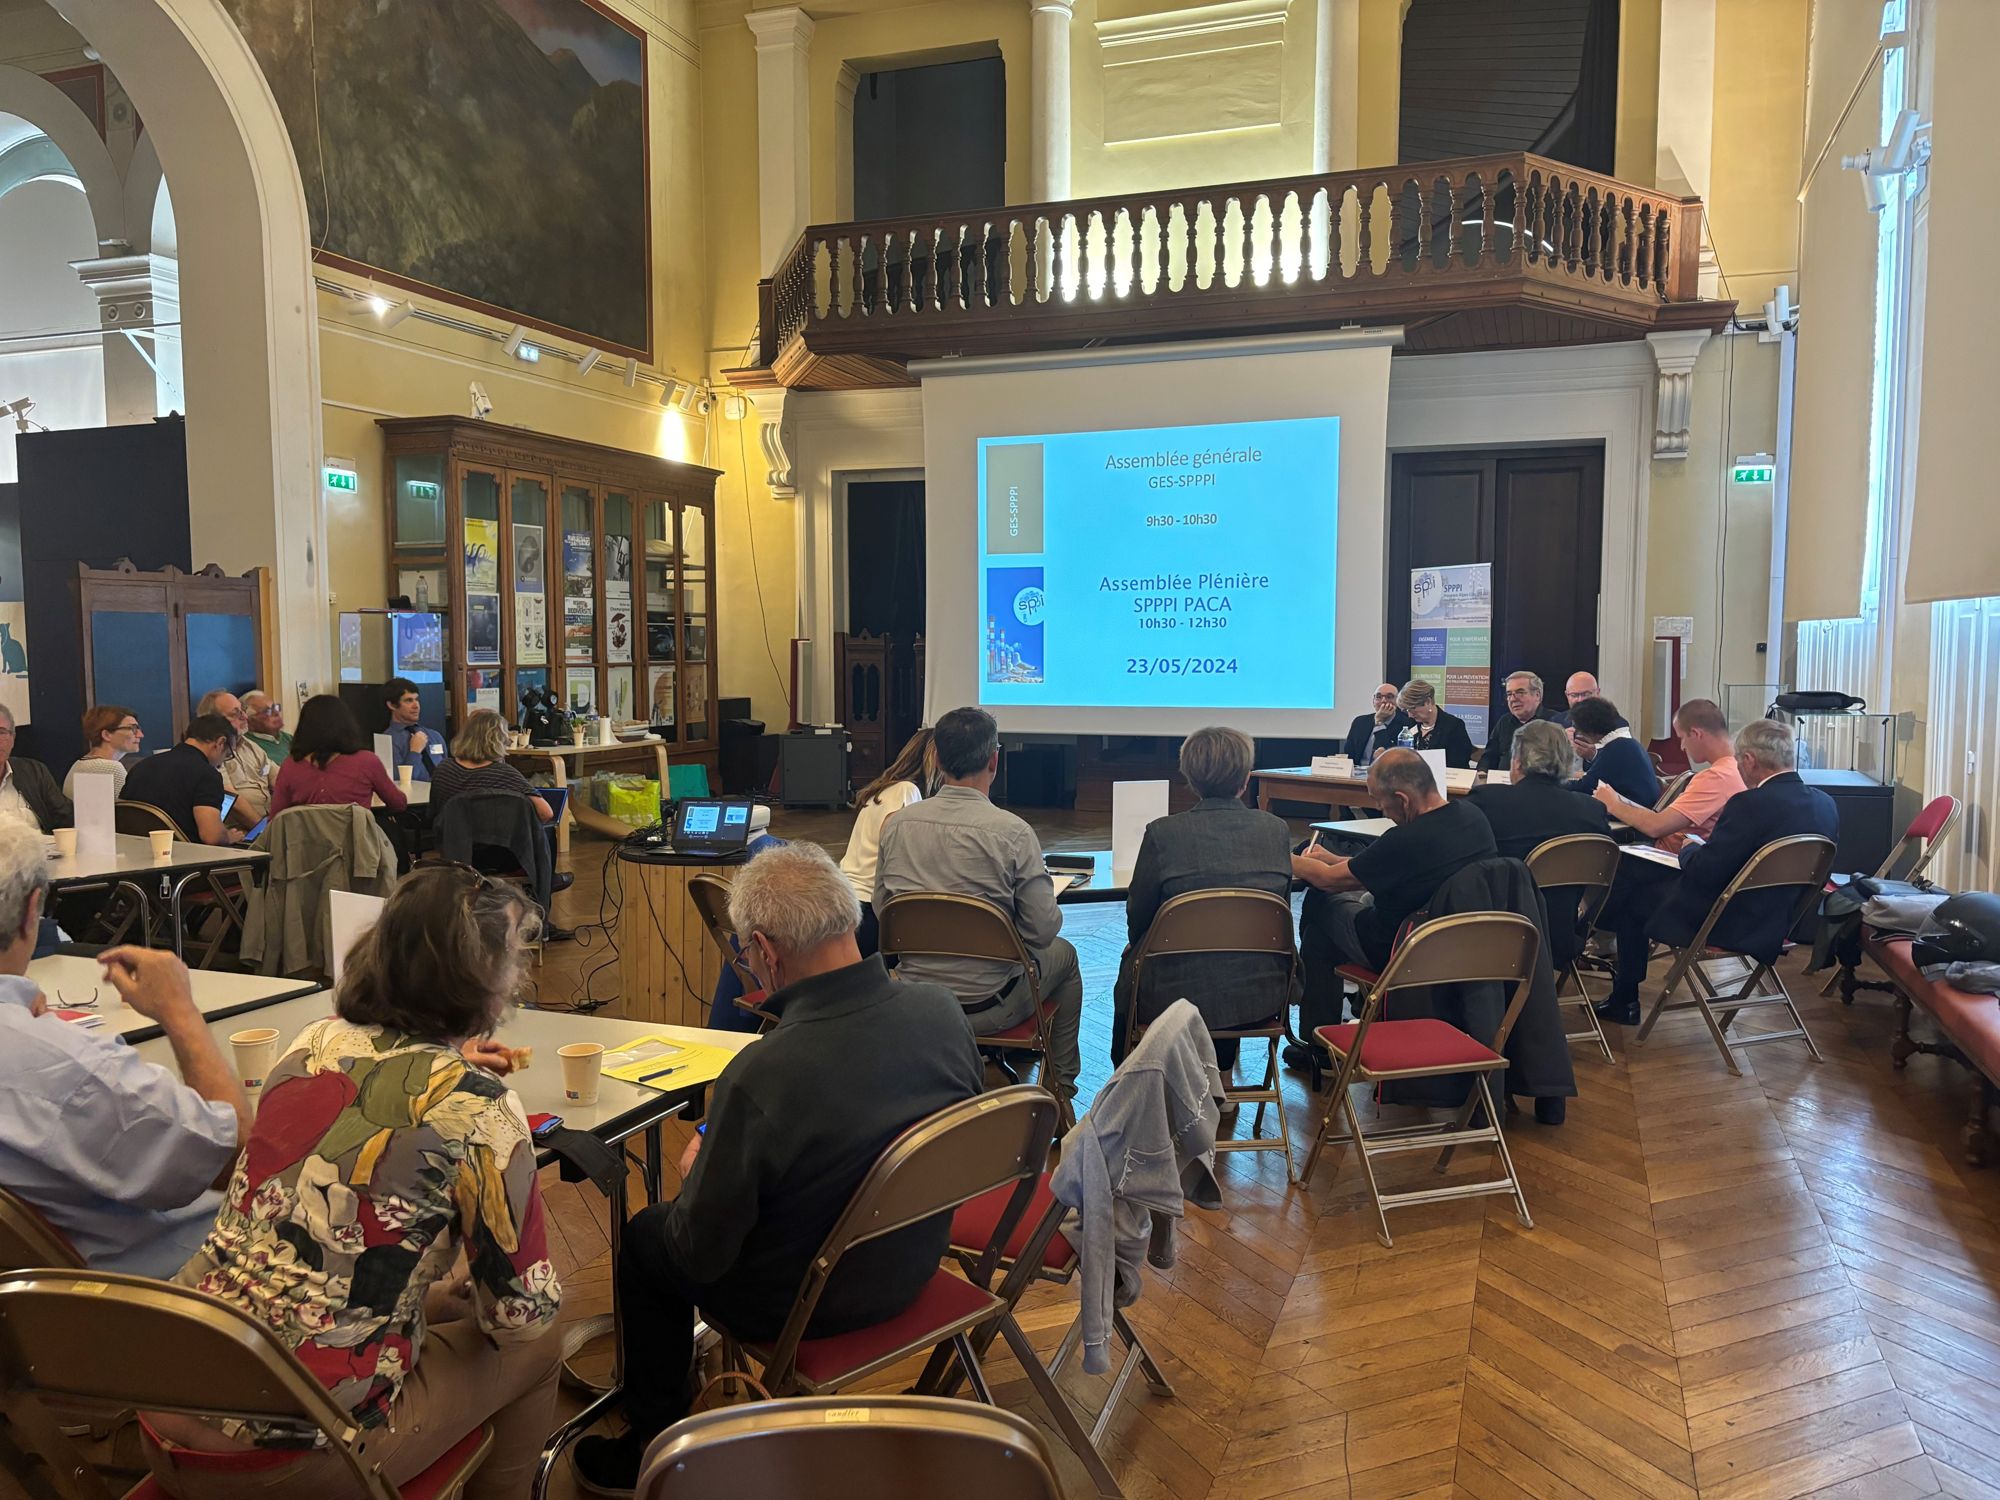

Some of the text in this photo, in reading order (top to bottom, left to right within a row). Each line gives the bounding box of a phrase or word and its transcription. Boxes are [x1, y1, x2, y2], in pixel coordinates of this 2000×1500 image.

[1105, 446, 1263, 470] Assemblée générale
[1148, 473, 1216, 489] GES-SPPPI
[1009, 486, 1019, 537] GES-SPPPI
[1146, 515, 1174, 527] 9h30
[1183, 513, 1218, 526] 10h30
[1099, 572, 1270, 592] Assemblée Plénière
[1444, 584, 1463, 593] SPPPI
[1133, 596, 1232, 613] SPPPI PACA
[1138, 617, 1177, 629] 10h30
[1188, 616, 1227, 629] 12h30
[1126, 657, 1239, 676] 23/05/2024
